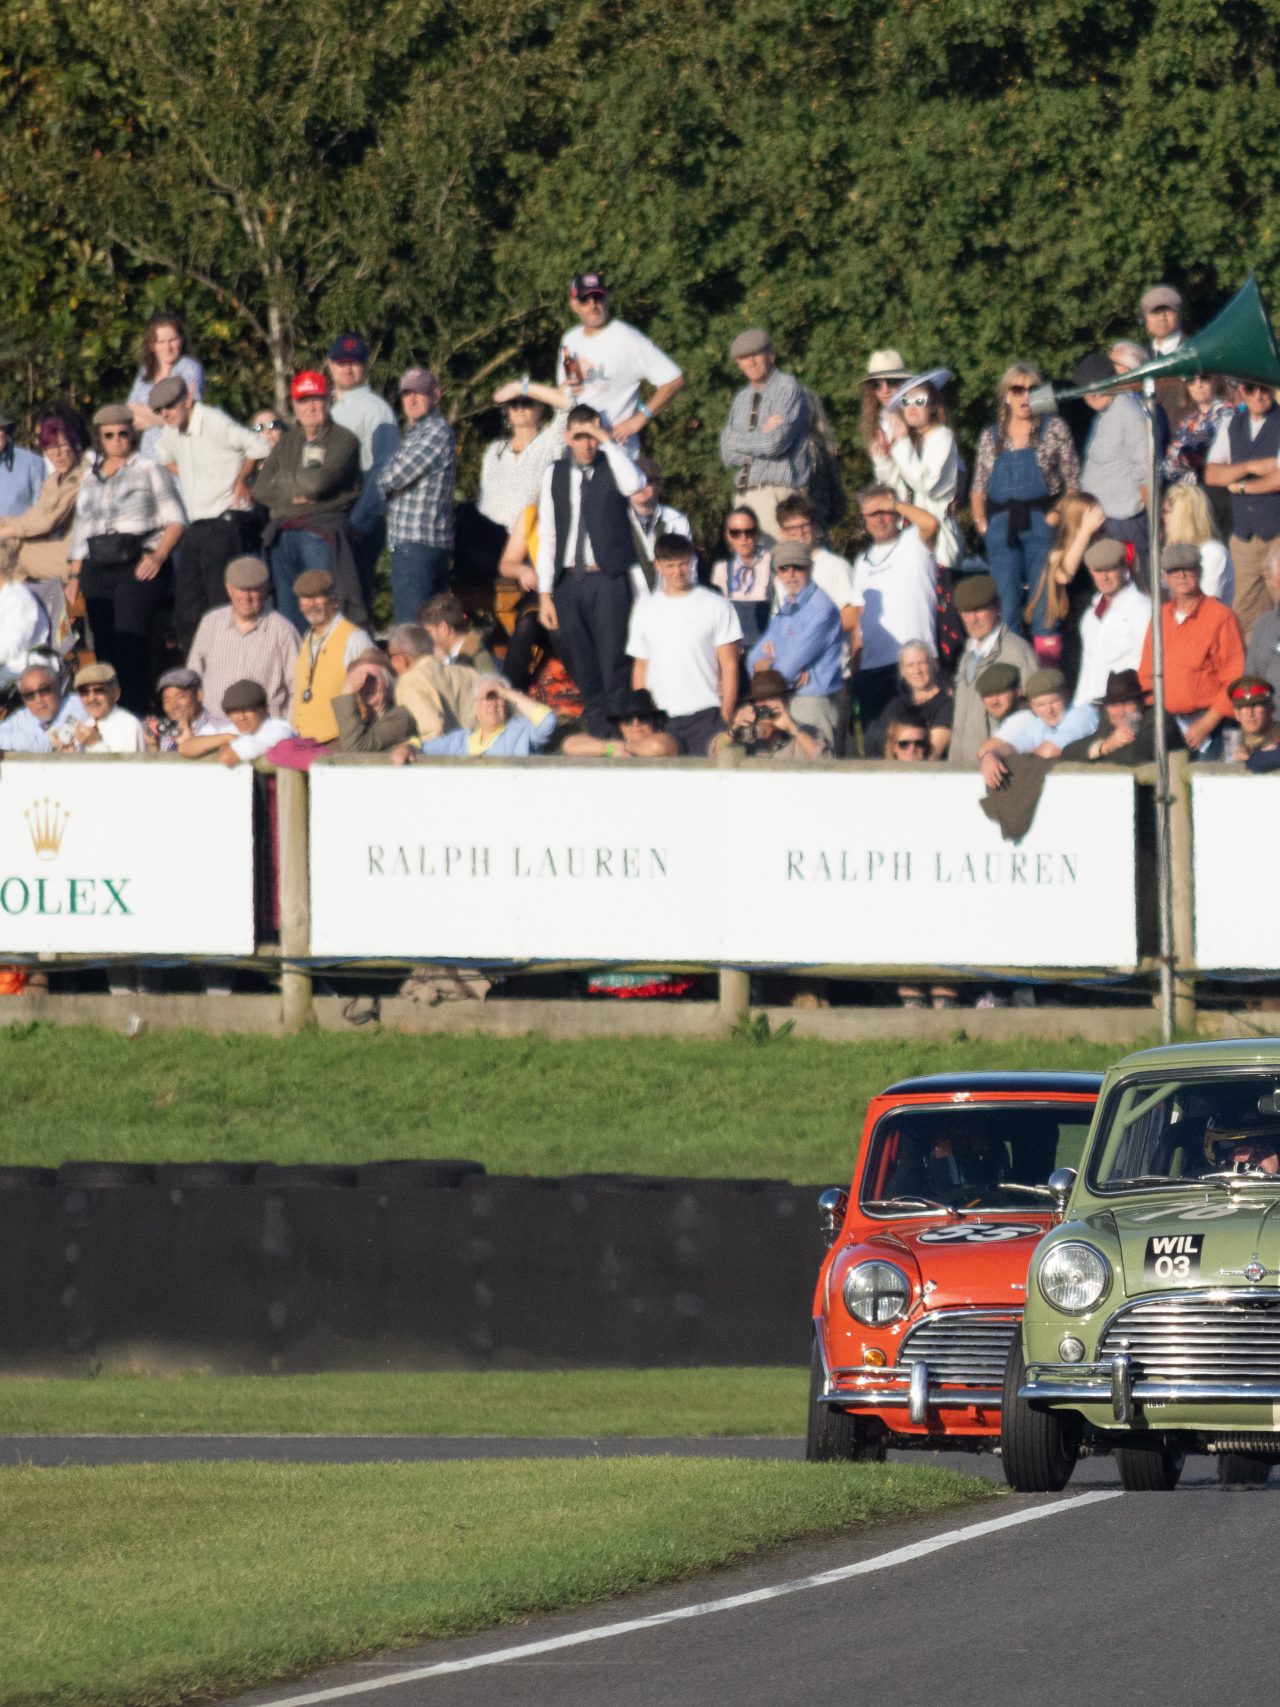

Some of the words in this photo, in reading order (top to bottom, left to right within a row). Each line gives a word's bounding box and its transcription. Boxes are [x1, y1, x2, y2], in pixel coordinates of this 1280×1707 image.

[367, 844, 490, 877] RALPH
[513, 846, 668, 879] LAUREN
[785, 850, 912, 883] RALPH
[934, 851, 1079, 885] LAUREN
[921, 1223, 1040, 1242] 55
[1152, 1236, 1198, 1254] WIL
[1154, 1255, 1190, 1278] 03
